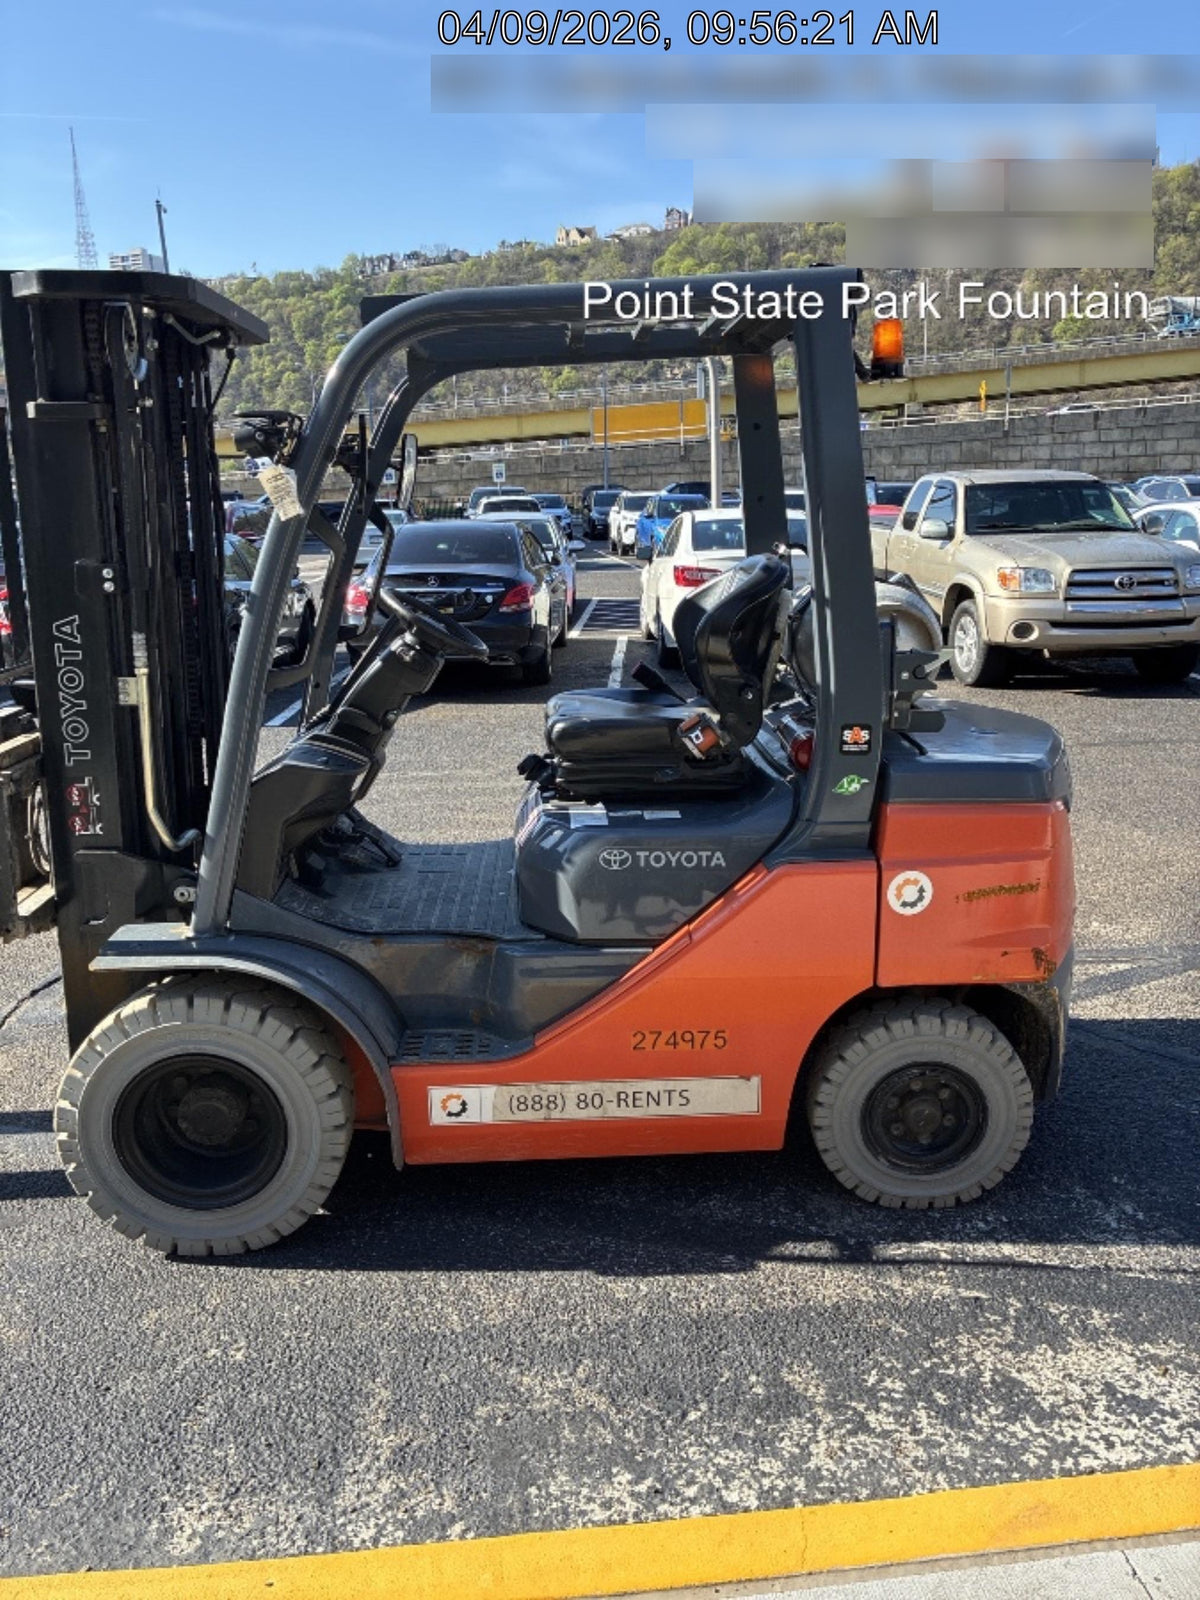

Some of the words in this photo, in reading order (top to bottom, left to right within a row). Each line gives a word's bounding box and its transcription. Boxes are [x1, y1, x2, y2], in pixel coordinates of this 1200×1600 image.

[53, 614, 92, 768] TOYOTA
[636, 850, 727, 868] TOYOTA
[631, 1030, 727, 1051] 274975
[508, 1092, 567, 1114] (888)
[576, 1088, 691, 1111] 80-RENTS
